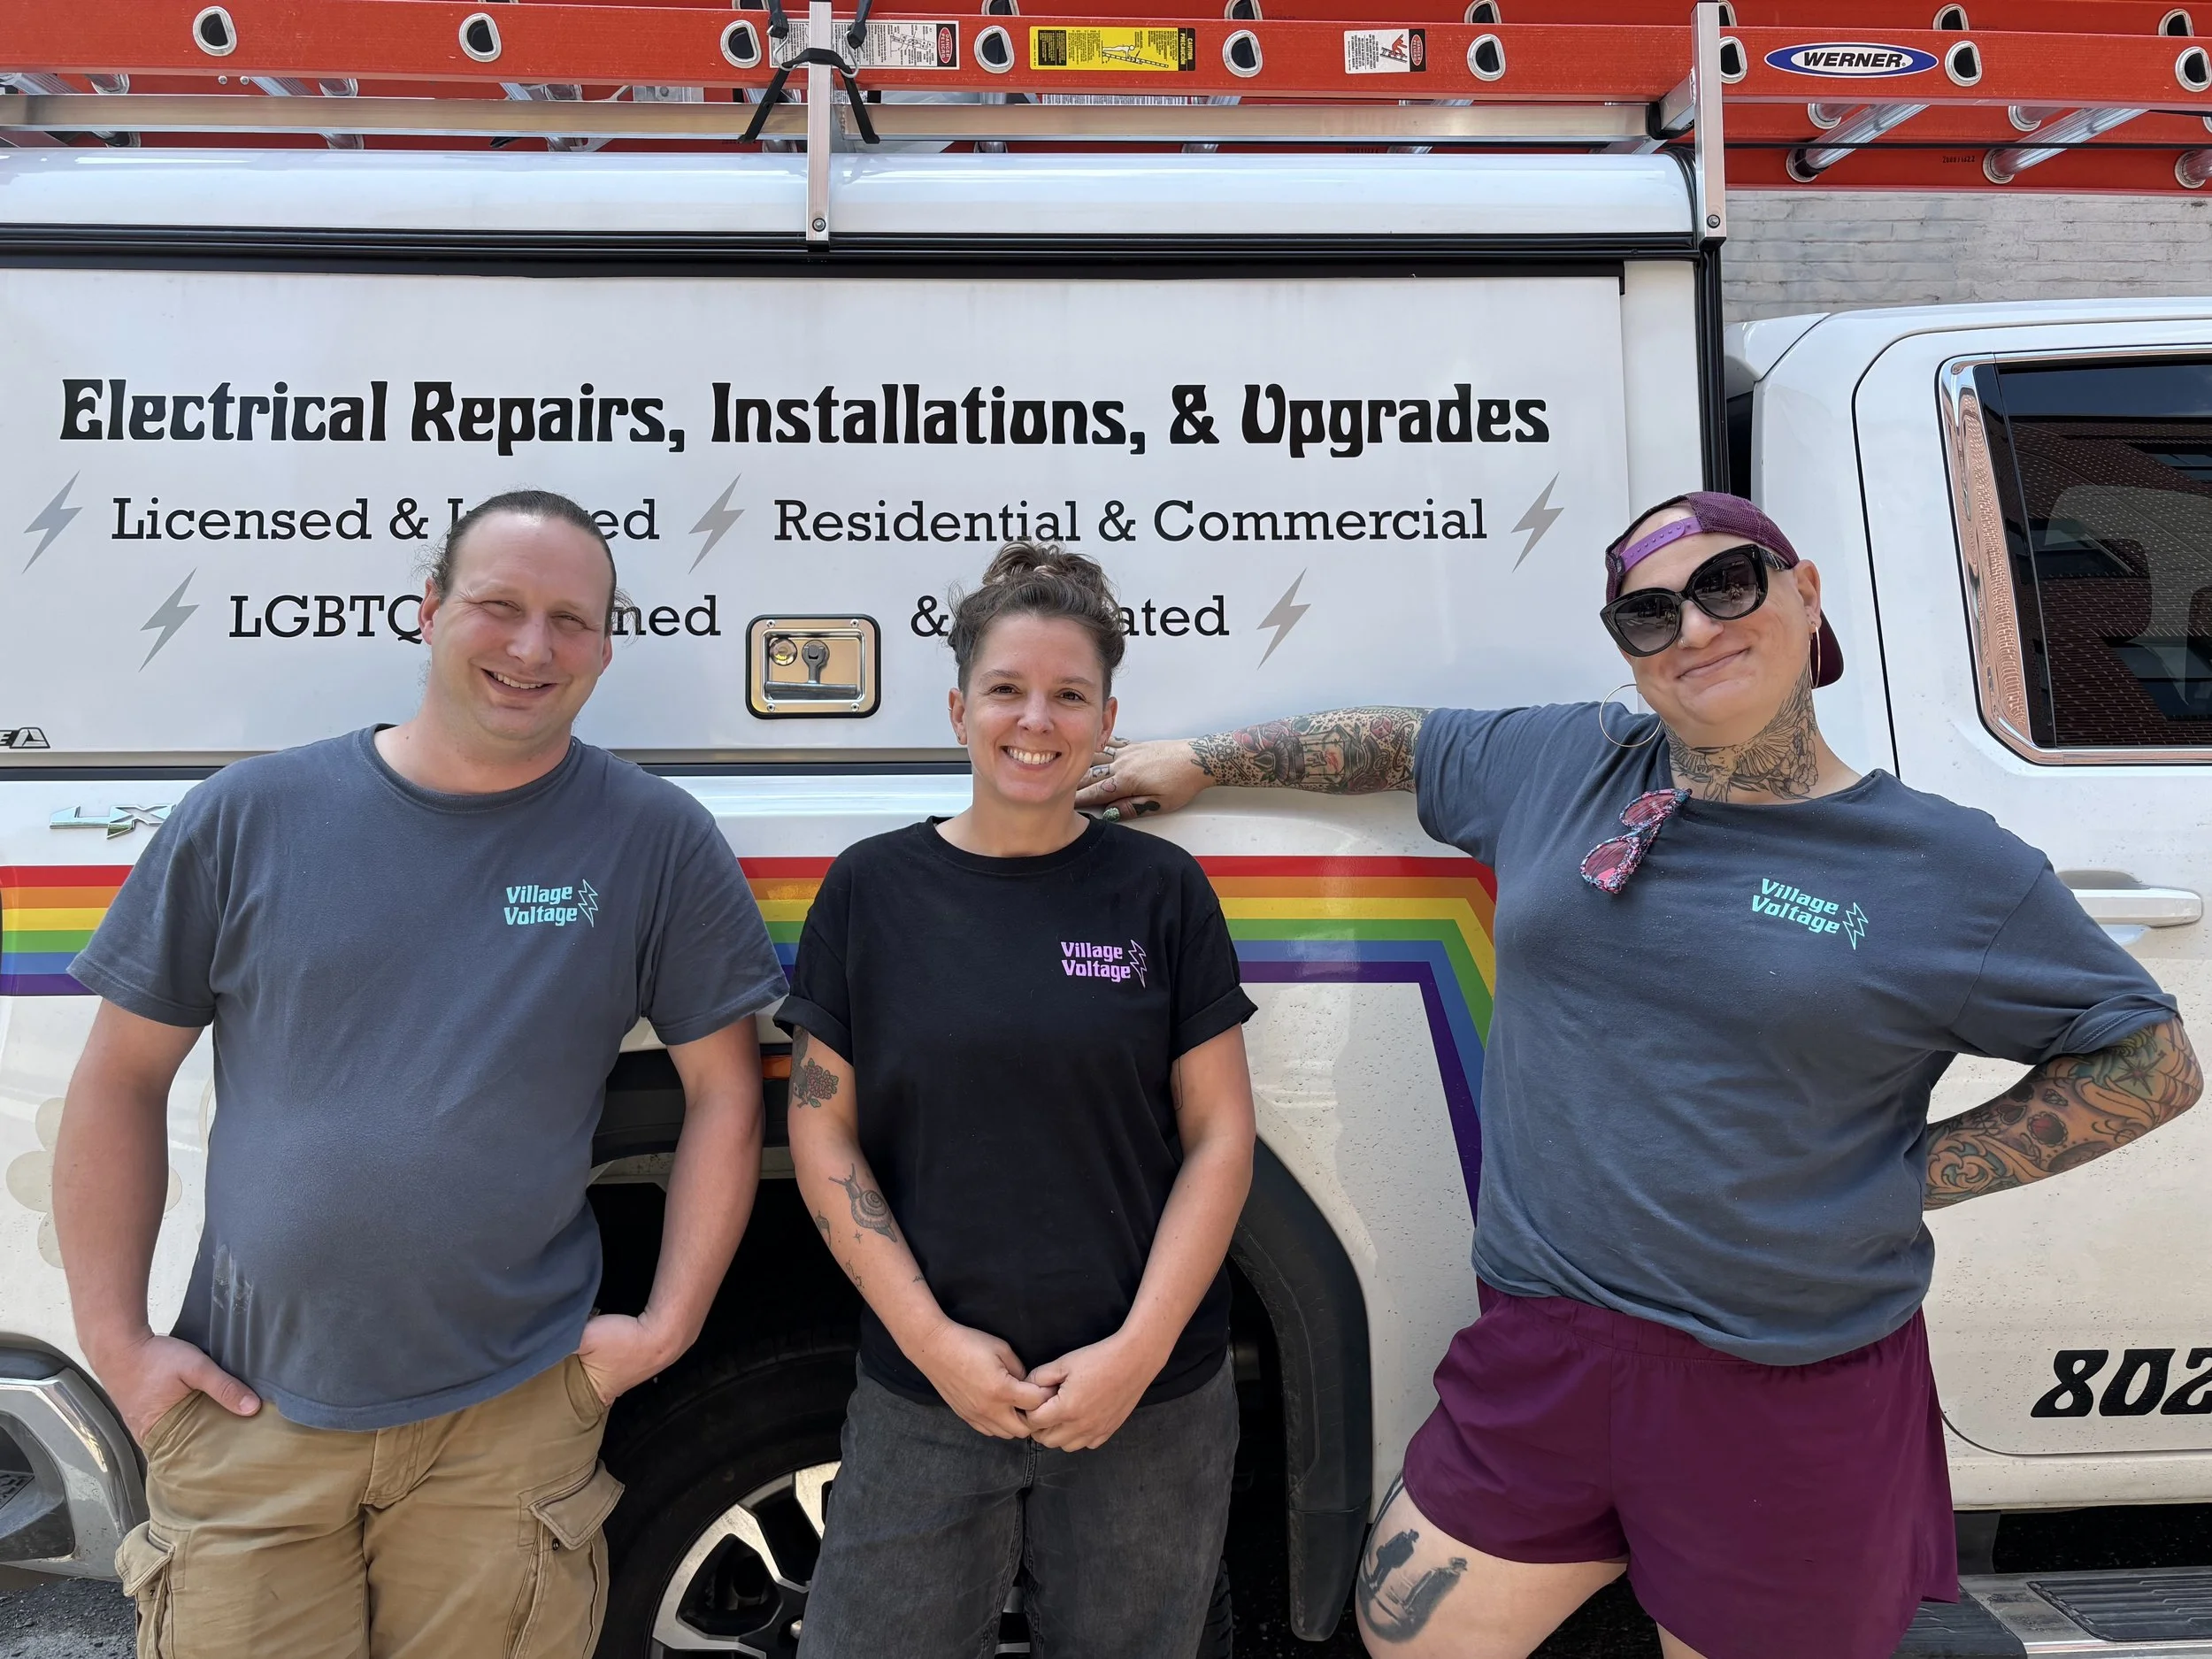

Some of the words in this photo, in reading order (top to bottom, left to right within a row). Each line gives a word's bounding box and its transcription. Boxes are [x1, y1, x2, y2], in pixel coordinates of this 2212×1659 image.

[1803, 52, 1904, 67] WERNER
[60, 380, 388, 441] Electrical
[411, 382, 685, 456] Repairs,
[711, 383, 1146, 456] Installations,
[1170, 384, 1220, 444] &
[1241, 384, 1550, 458] Upgrades
[111, 497, 373, 541] Licensed
[389, 497, 429, 541] &
[774, 499, 1081, 541] Residential
[1098, 500, 1136, 541] &
[1154, 499, 1487, 541] Commercial
[611, 595, 721, 637] ned
[910, 595, 949, 637] &
[1121, 595, 1230, 637] ated
[506, 885, 572, 905] Village
[1752, 895, 1840, 933] Voltage
[1761, 878, 1839, 915] Village
[503, 905, 578, 927] Voltage
[1060, 941, 1123, 963] Village
[1061, 959, 1131, 983] Voltage
[2031, 1348, 2212, 1417] 802
